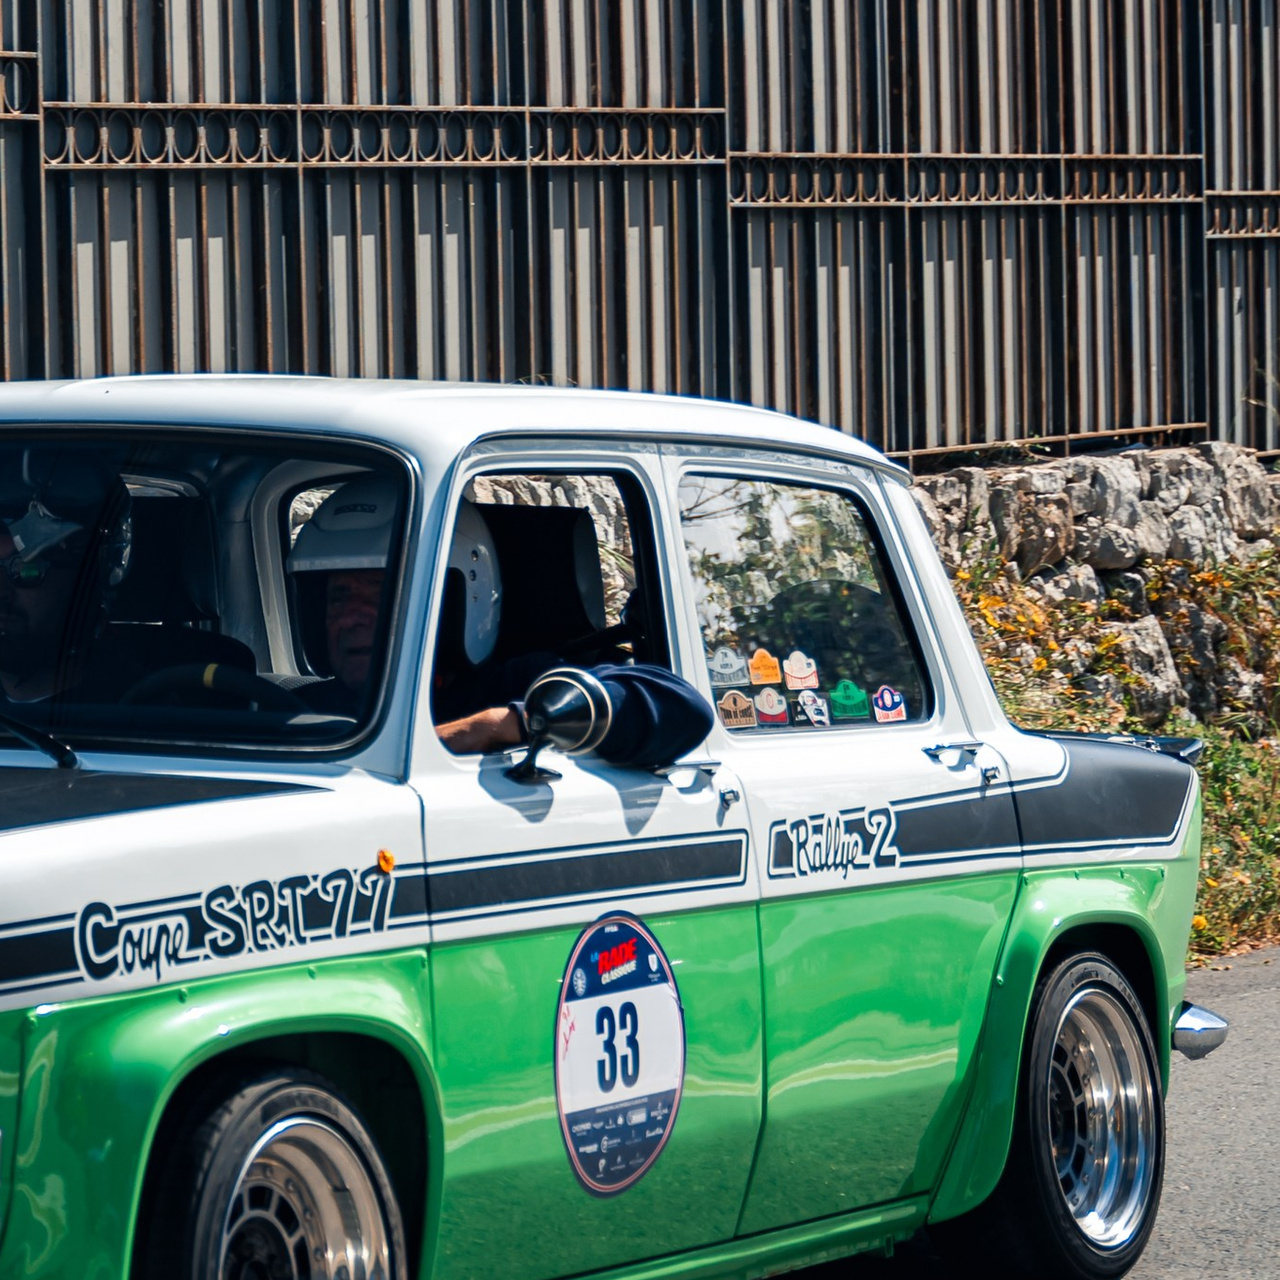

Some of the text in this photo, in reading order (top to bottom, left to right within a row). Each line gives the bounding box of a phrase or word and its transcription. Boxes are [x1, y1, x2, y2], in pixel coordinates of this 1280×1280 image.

[789, 807, 897, 880] Rallye 2
[79, 901, 190, 982] Coupe
[598, 937, 638, 975] RADE
[594, 1001, 641, 1094] 33
